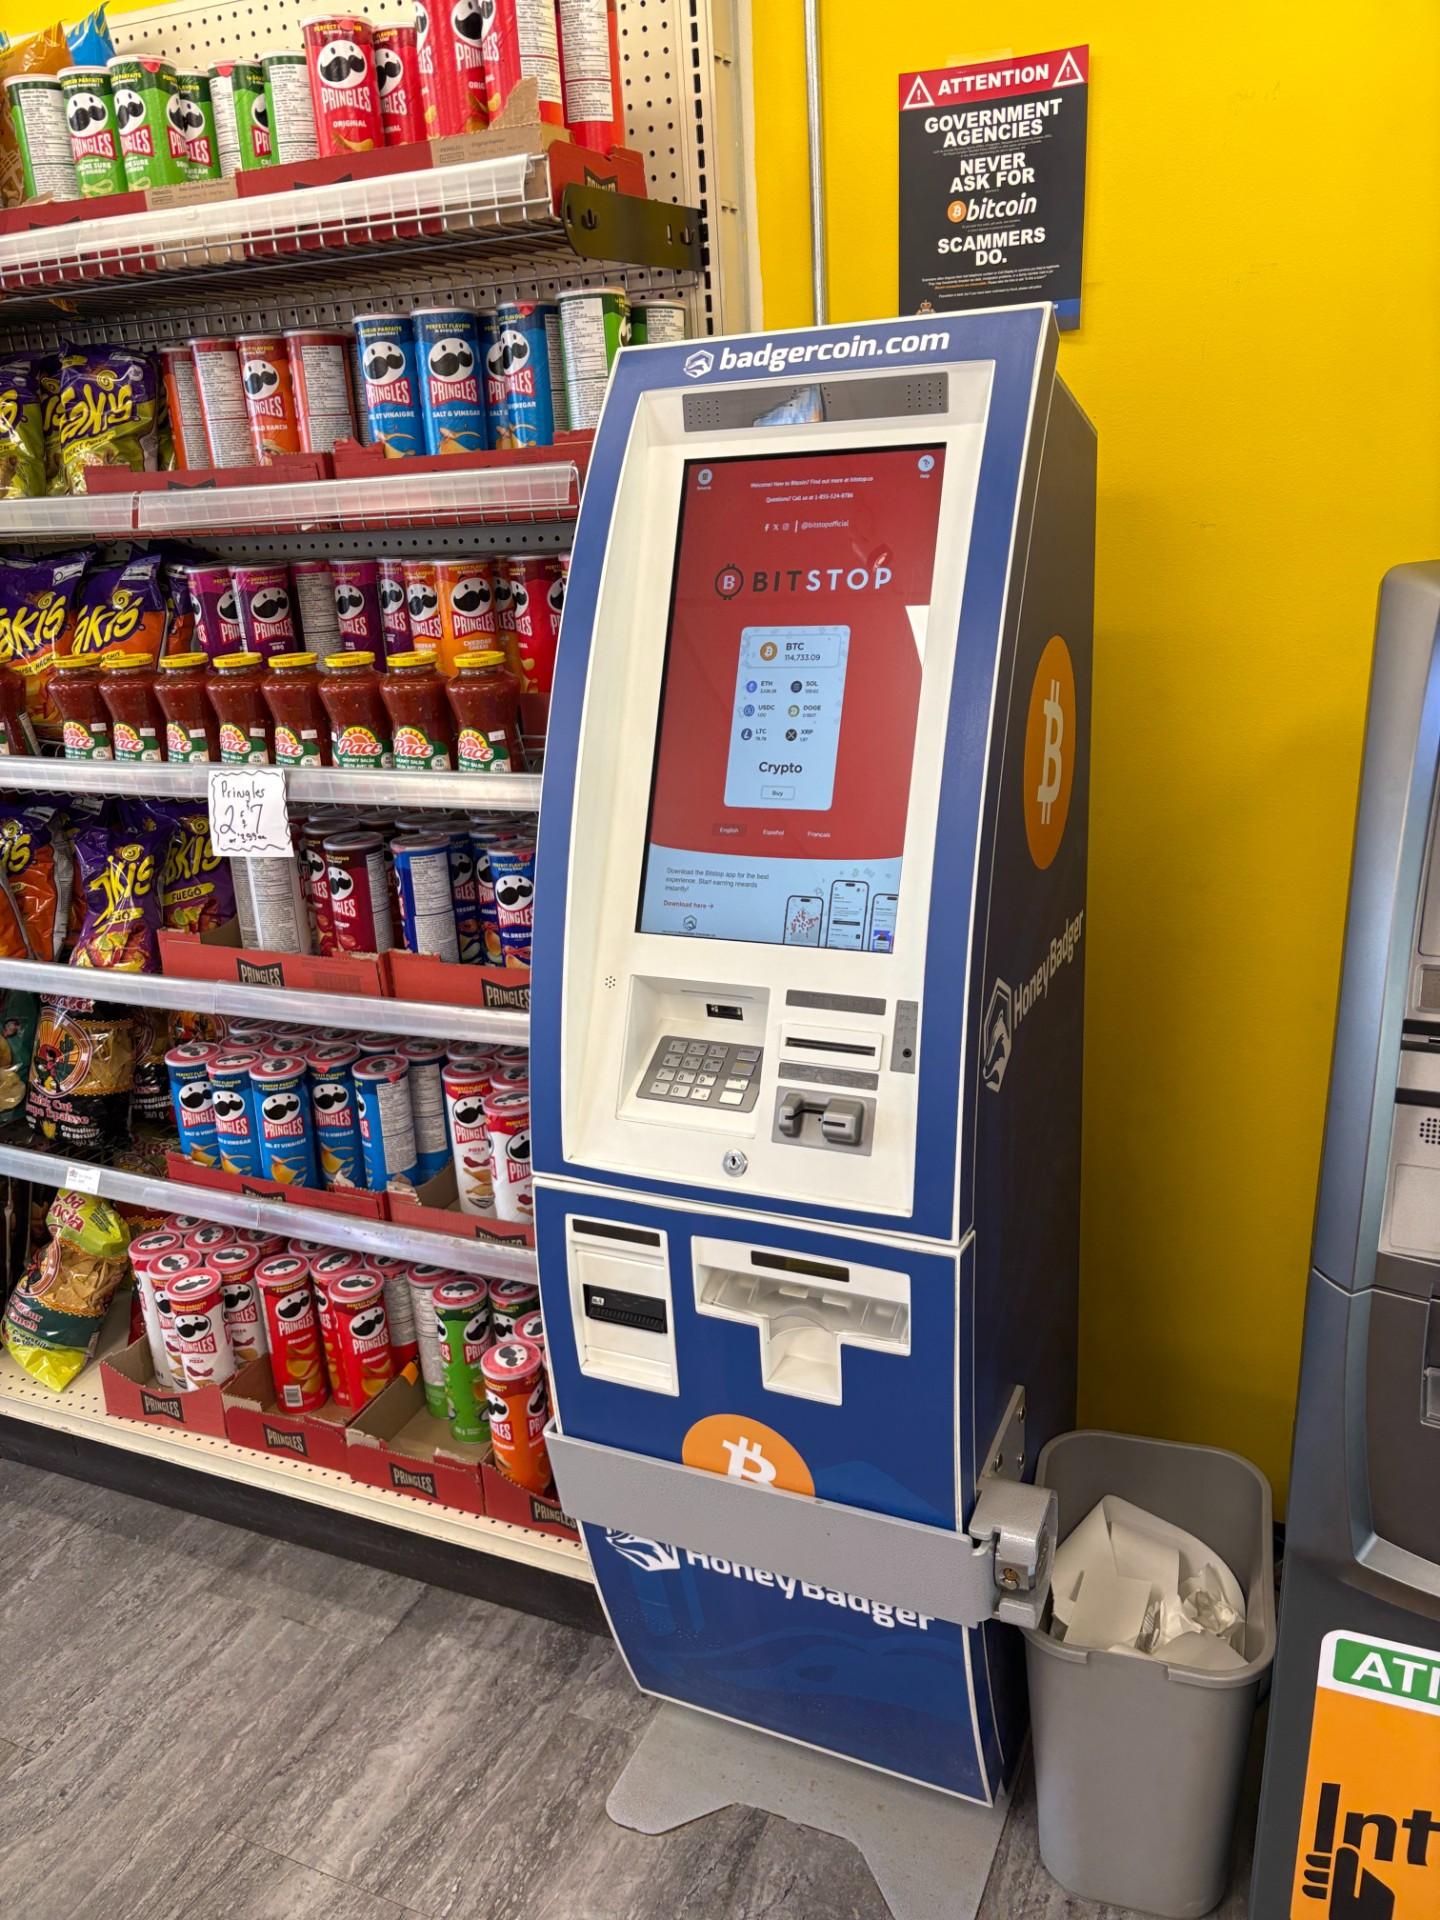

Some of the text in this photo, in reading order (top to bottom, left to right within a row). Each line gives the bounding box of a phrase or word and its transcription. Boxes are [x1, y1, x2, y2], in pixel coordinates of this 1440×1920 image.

[454, 42, 483, 73] PRIN
[938, 63, 1049, 97] ATTENTION
[321, 86, 372, 114] PRINGLES
[381, 89, 407, 116] GLES
[332, 119, 367, 128] ORIGINAL
[924, 98, 1063, 134] GOVERNMENT
[943, 118, 1043, 148] AGENCIES
[960, 152, 1026, 176] NEVER
[949, 167, 1036, 194] ASK FOR
[966, 191, 1037, 222] bitcoin
[937, 226, 1046, 254] SCAMMERS
[975, 248, 1008, 267] DO.
[719, 331, 950, 372] badgercoin.com
[366, 380, 411, 408] PRINGLES
[430, 378, 478, 407] PRINGLES
[382, 410, 415, 419] VINAIGRE
[432, 410, 446, 418] SALT
[453, 409, 481, 418] VINEGAR
[751, 566, 892, 594] BITSTOP
[254, 618, 293, 642] PRINGLES
[453, 611, 495, 637] PRINGLES
[785, 642, 805, 651] BTC
[758, 762, 803, 776] Crypto
[221, 780, 266, 802] Pringles
[772, 789, 784, 798] Buy
[220, 805, 236, 834] 2
[719, 827, 739, 835] English
[762, 829, 785, 837] Español
[666, 867, 694, 876] Download
[172, 887, 202, 901] FUEGO
[663, 900, 692, 908] Download
[498, 907, 532, 929] PRINGLE
[240, 964, 282, 986] PRINGLES
[1014, 909, 1084, 1030] HoneyBadger
[486, 985, 531, 1009] PRINGLES
[182, 1109, 216, 1127] PRINGLE
[265, 1117, 304, 1139] PRINGLES
[455, 1125, 488, 1142] PRINGL
[278, 1310, 315, 1337] PRINGLES
[353, 1328, 389, 1355] PRINGLES
[144, 1396, 181, 1418] PRINGLES
[266, 1428, 304, 1451] PRINGLES
[393, 1468, 434, 1493] PRINGLES
[533, 1500, 578, 1529] PRINGLES
[685, 1549, 935, 1631] HoneyBadger
